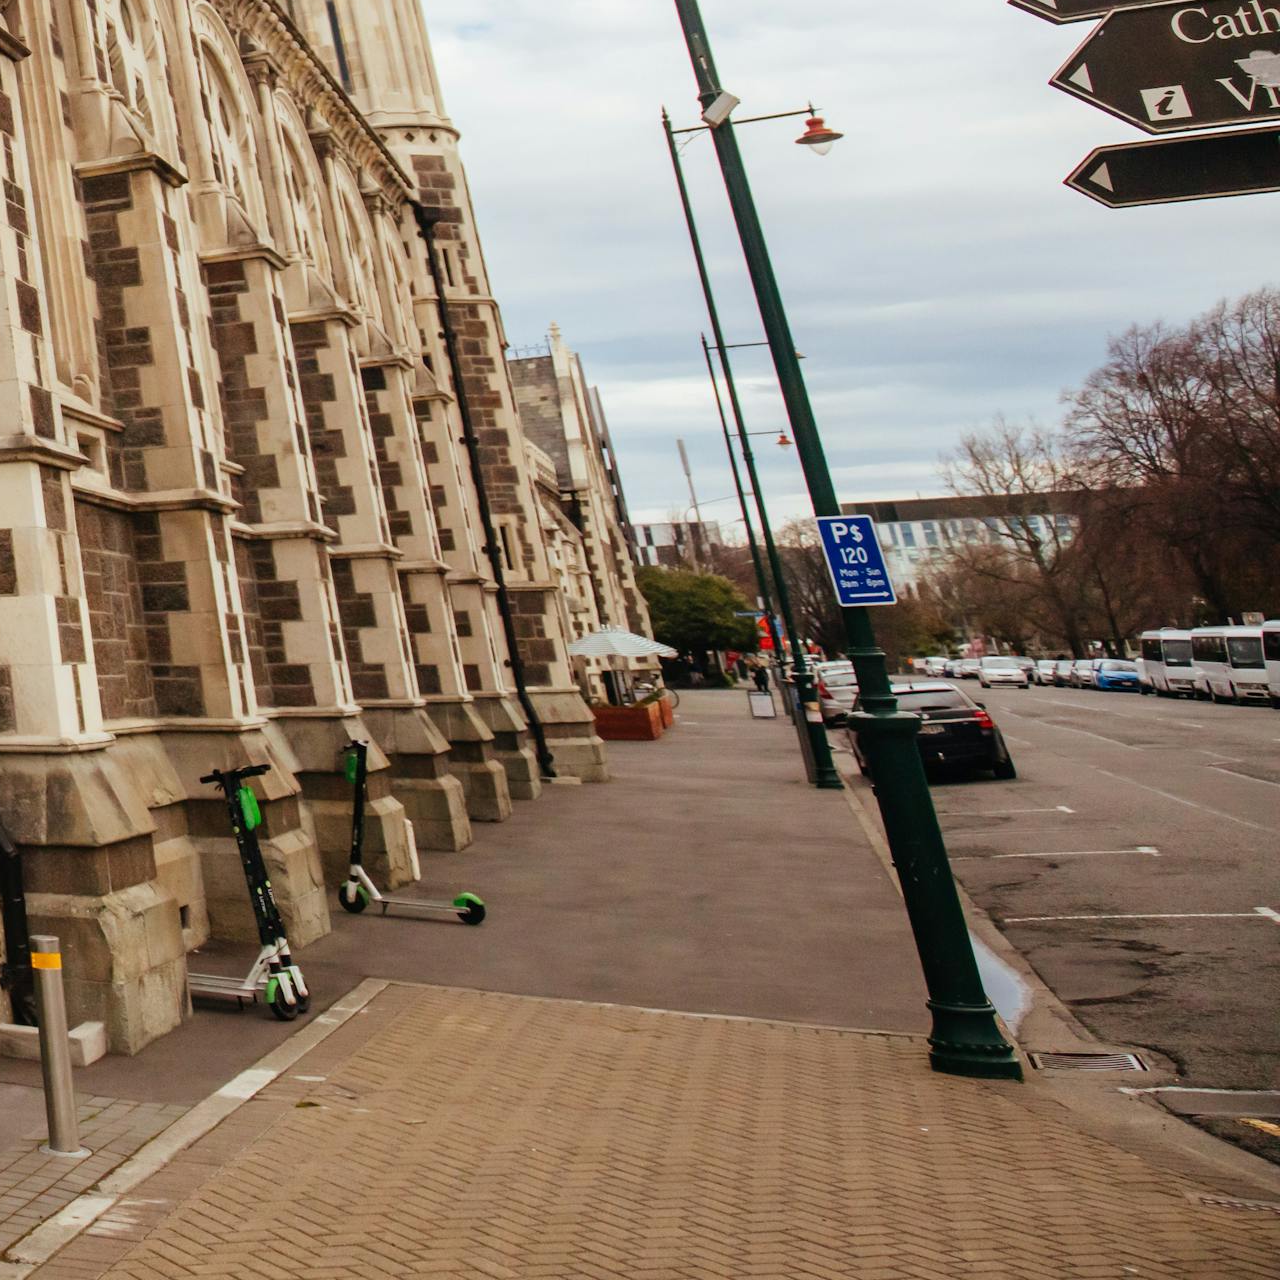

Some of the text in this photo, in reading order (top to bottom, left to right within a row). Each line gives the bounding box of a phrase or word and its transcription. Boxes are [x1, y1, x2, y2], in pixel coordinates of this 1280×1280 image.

[1171, 0, 1280, 43] Cath
[840, 547, 868, 564] 120
[840, 568, 859, 577] Mon
